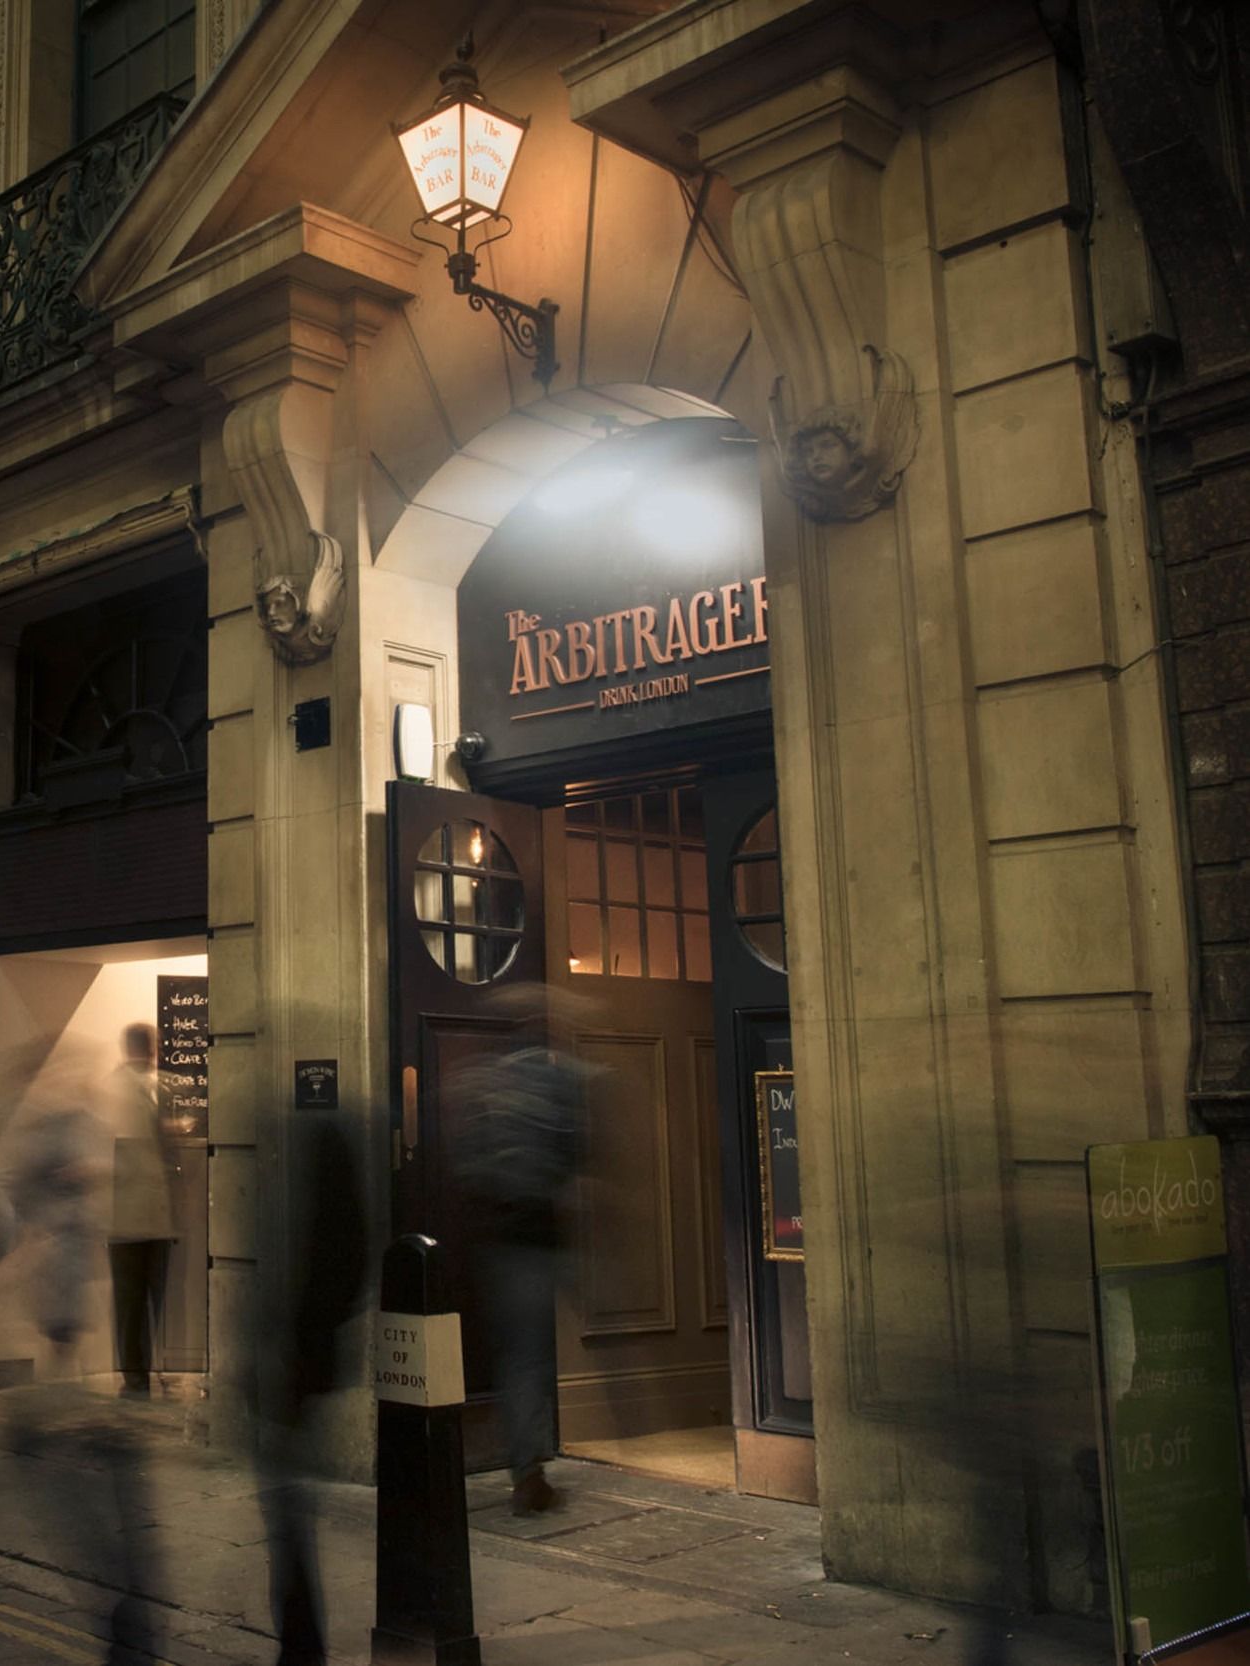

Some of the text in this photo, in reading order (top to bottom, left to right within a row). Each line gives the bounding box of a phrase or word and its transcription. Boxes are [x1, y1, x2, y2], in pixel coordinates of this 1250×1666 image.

[423, 126, 442, 142] The
[483, 118, 501, 137] The
[426, 168, 454, 193] BAR
[471, 166, 497, 190] BAR
[504, 608, 541, 642] The
[599, 673, 690, 709] DRINK LONDON
[1101, 1149, 1215, 1235] abokado
[383, 1328, 418, 1343] CITY
[393, 1351, 408, 1364] OF
[375, 1369, 427, 1389] LONDON
[1119, 1424, 1190, 1473] 1/3 off
